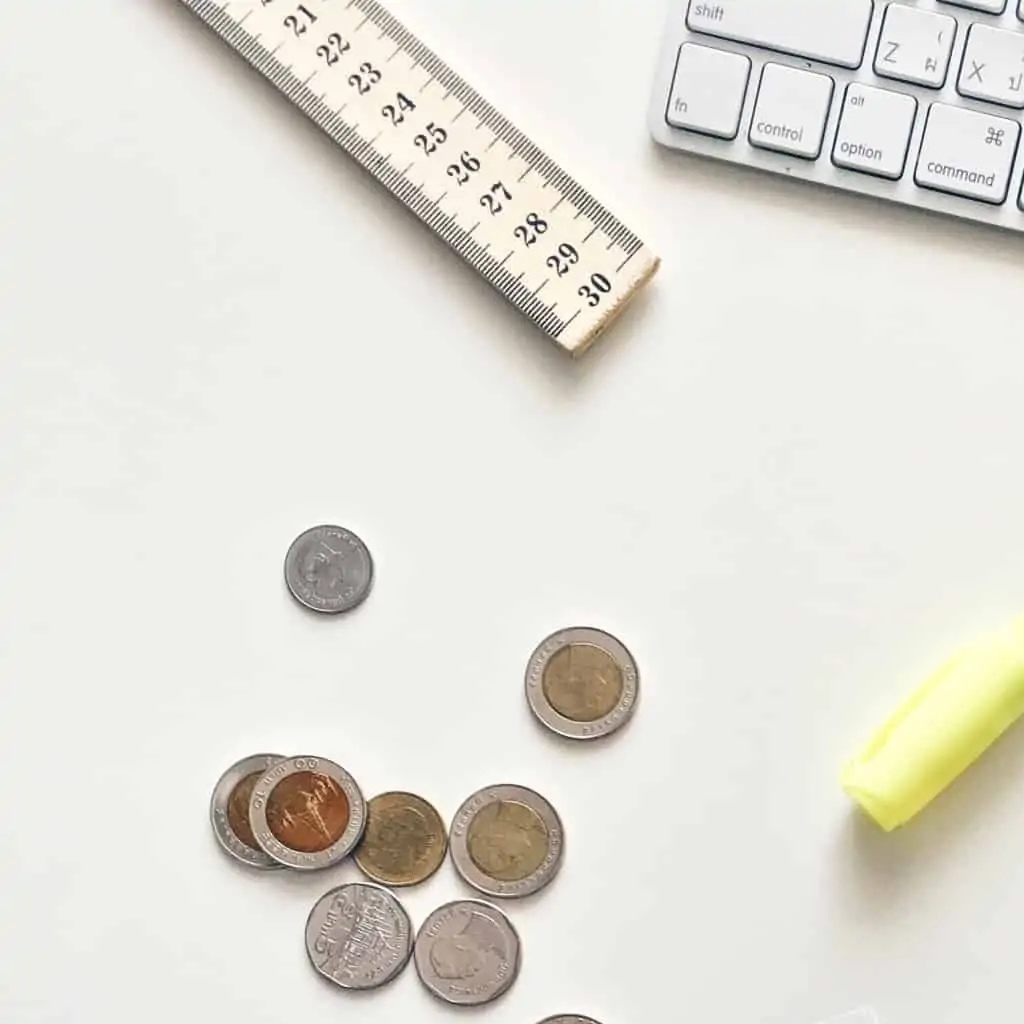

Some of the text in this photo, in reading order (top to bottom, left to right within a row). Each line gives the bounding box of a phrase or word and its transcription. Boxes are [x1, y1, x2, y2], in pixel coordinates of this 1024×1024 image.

[283, 4, 318, 37] 21
[694, 3, 724, 20] shift
[316, 32, 351, 66] 22
[878, 42, 900, 63] Z
[348, 62, 382, 95] 23
[967, 62, 986, 82] X
[381, 92, 417, 127] 24
[674, 99, 688, 113] fn
[850, 94, 864, 106] alt
[413, 122, 448, 157] 25
[757, 120, 803, 142] control
[840, 140, 882, 161] option
[446, 151, 481, 186] 26
[927, 160, 995, 186] command
[479, 181, 513, 216] 27
[514, 212, 548, 247] 28
[546, 243, 580, 277] 29
[577, 272, 612, 307] 30
